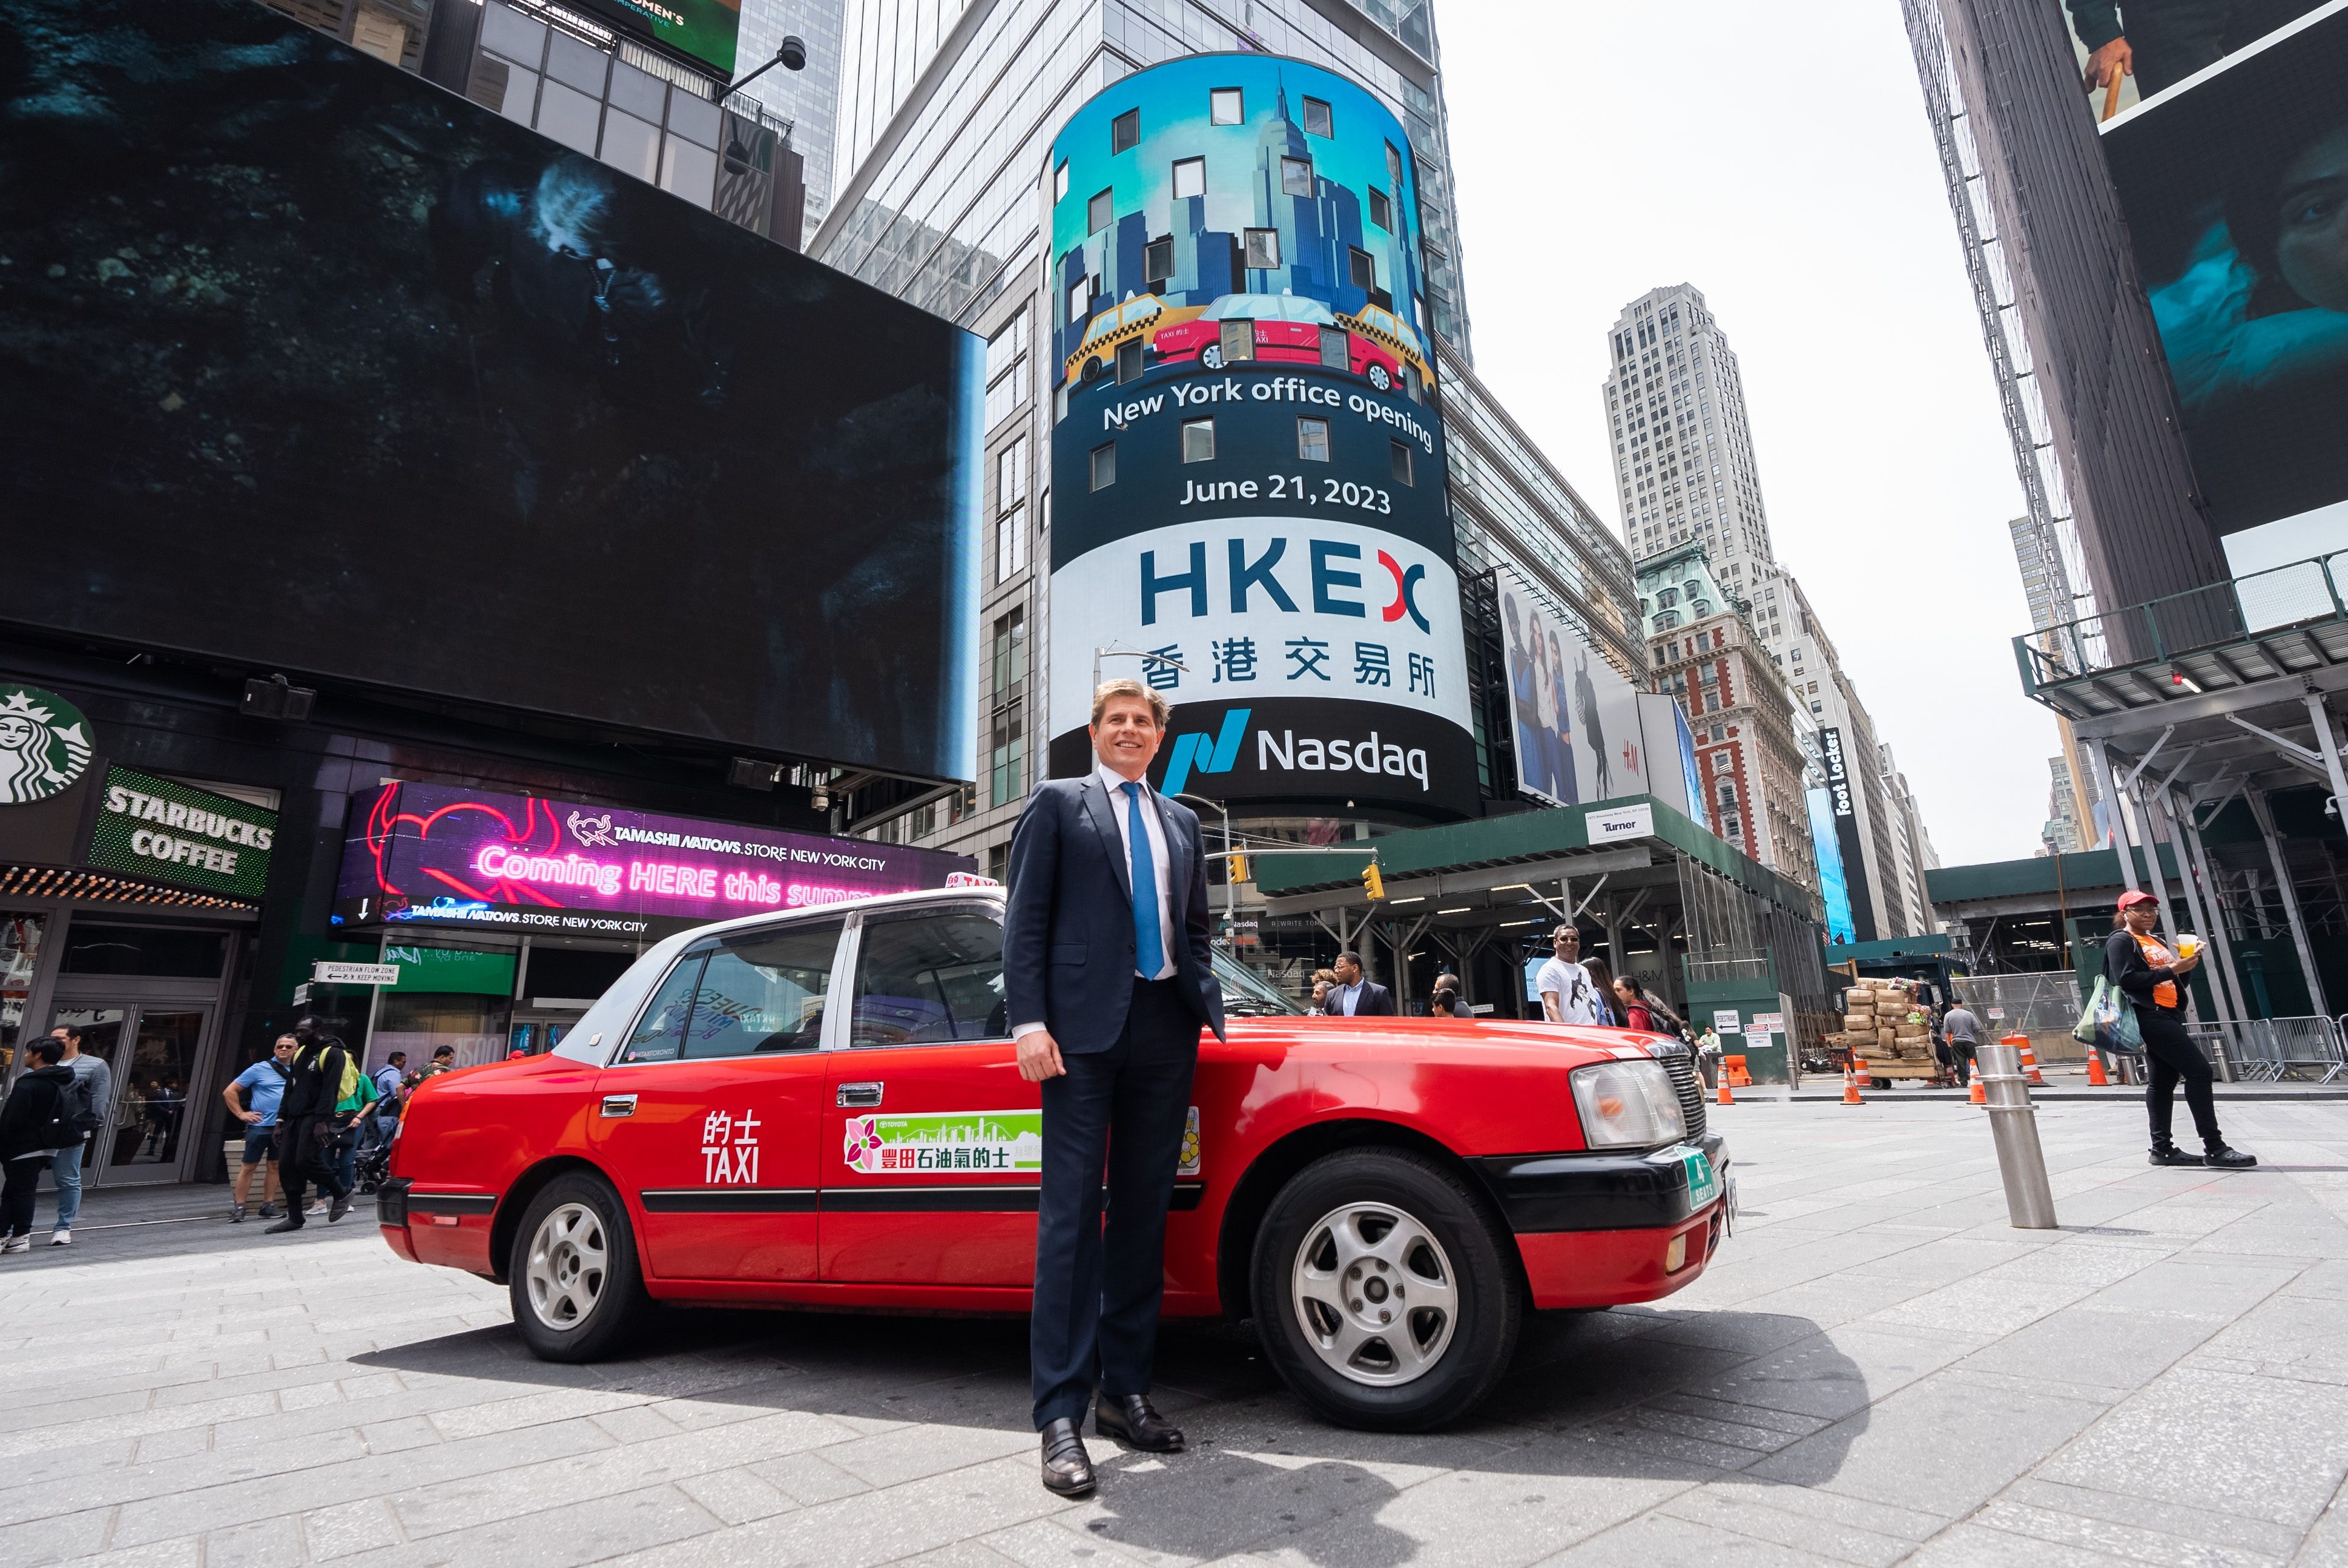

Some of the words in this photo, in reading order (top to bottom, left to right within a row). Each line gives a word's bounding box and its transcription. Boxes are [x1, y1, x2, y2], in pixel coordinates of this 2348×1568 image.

[632, 0, 684, 26] OMEN'S
[1104, 394, 1163, 430] New
[1170, 377, 1242, 407] York
[1251, 377, 1341, 407] office
[1348, 395, 1433, 454] opening
[1179, 476, 1259, 506] June
[1268, 475, 1317, 506] 21,
[1324, 478, 1391, 515] 2023
[1140, 538, 1431, 635] HKEX
[1142, 636, 1436, 699] 香港交易所
[1258, 730, 1428, 792] Nasdaq
[1833, 783, 1851, 816] Foot
[106, 785, 273, 851] STARBUCKS
[1603, 821, 1636, 832] Turner
[131, 829, 239, 875] COFFEE
[615, 826, 680, 847] TAMASHII
[745, 843, 787, 861] STORE
[790, 849, 820, 864] NEW
[823, 853, 858, 870] YORK
[857, 857, 886, 872] CITY
[477, 845, 622, 895] Coming
[630, 861, 716, 899] HERE
[725, 869, 781, 904] this
[948, 875, 958, 888] 的
[964, 876, 998, 887] TAX
[523, 914, 559, 927] STORE
[562, 917, 589, 928] NEW
[590, 918, 622, 931] YORK
[622, 921, 648, 932] CITY
[1268, 969, 1305, 979] Nasdaq
[1632, 969, 1664, 982] H&M
[454, 1038, 499, 1068] 1500
[702, 1109, 762, 1145] 的士
[701, 1146, 759, 1185] TAXI
[881, 1147, 1010, 1168] 豐田石油氣的士
[1695, 1158, 1705, 1183] 4
[1695, 1184, 1713, 1202] SEATS
